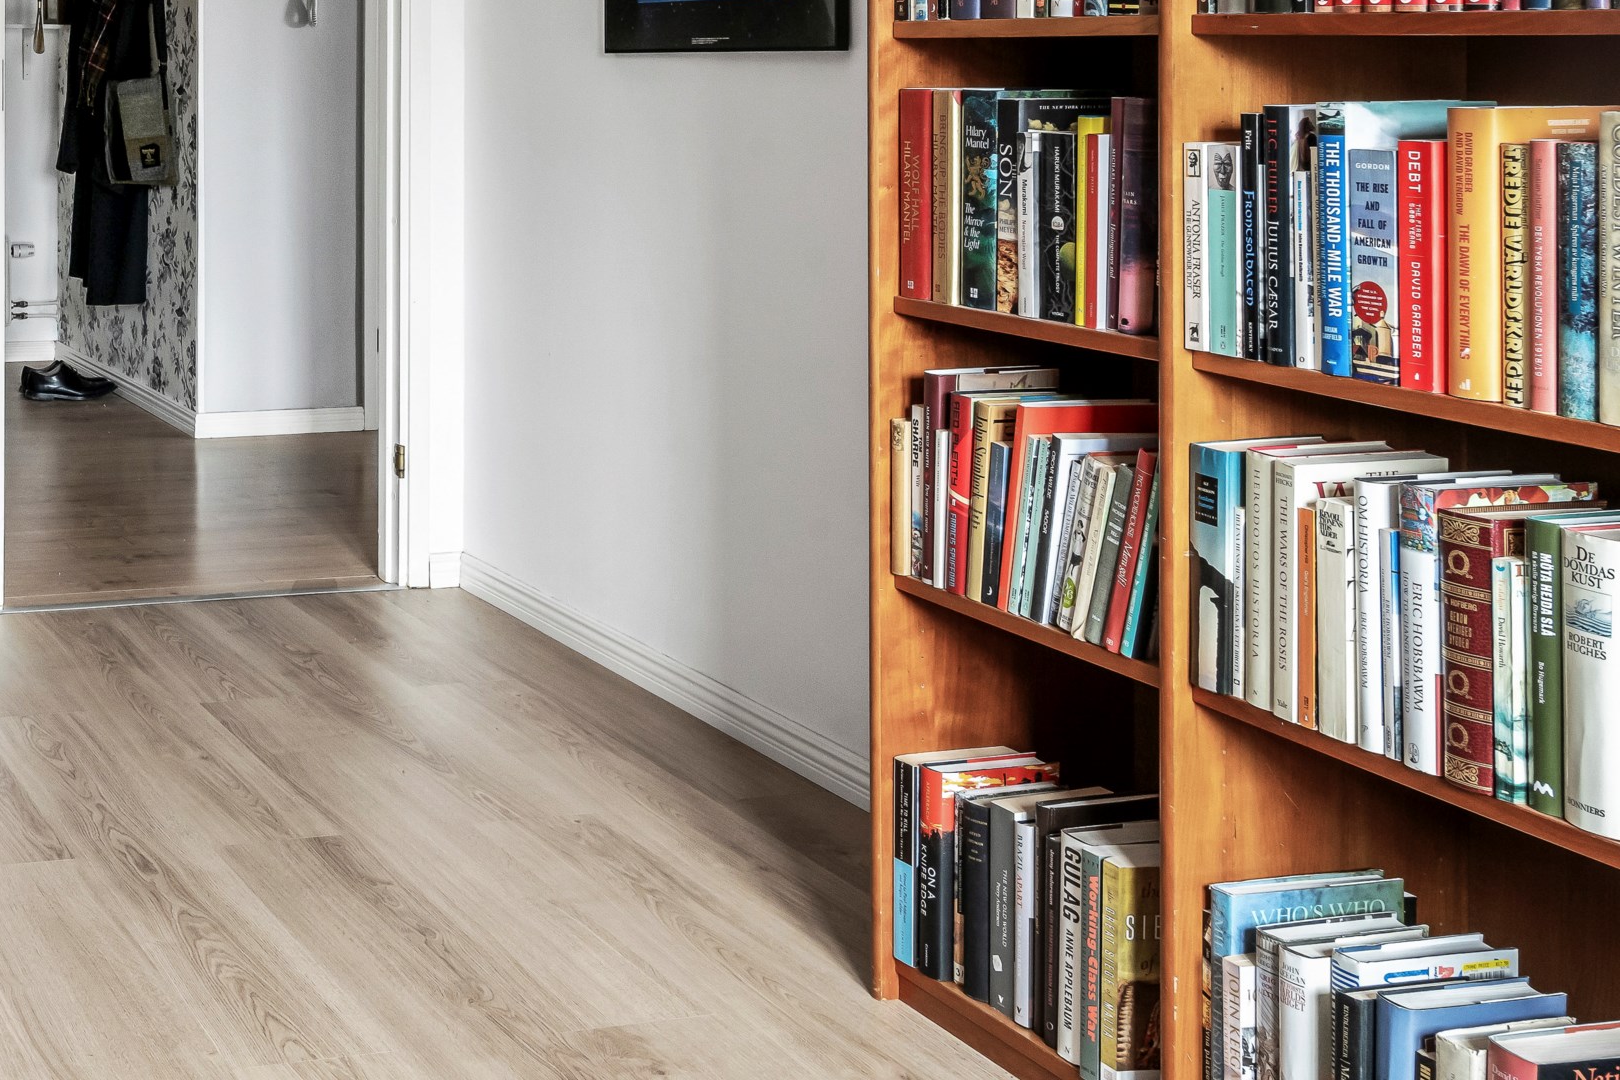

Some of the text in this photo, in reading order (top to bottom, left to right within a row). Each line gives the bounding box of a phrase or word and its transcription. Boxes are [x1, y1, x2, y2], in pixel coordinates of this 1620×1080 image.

[966, 125, 987, 140] Hilary
[966, 136, 990, 149] Mantel
[1000, 144, 1012, 198] SON
[1355, 162, 1390, 171] GORDON
[1408, 150, 1421, 193] DEBT
[1464, 159, 1473, 193] GRAEBER
[903, 141, 911, 243] HILARY MANTEL
[1356, 182, 1389, 194] THE RISE
[1365, 201, 1380, 212] AND
[1455, 173, 1464, 215] WENGROW
[1267, 220, 1279, 270] JULIUS
[1326, 141, 1342, 317] THE WAR
[1354, 237, 1391, 249] AMERICAN
[1358, 219, 1387, 230] FALL OF
[1357, 254, 1388, 267] GROWTH
[1411, 262, 1422, 359] DAVID GRAEBER
[1534, 275, 1543, 339] REVOLUTIONEN
[912, 419, 920, 468] SHARPE
[951, 433, 960, 487] PLENTY
[1252, 469, 1260, 658] HERODOTOS HISTORIA
[1358, 525, 1369, 594] HISTORIA
[1576, 545, 1596, 564] DE
[1279, 496, 1288, 671] THE WARS THE ROSES
[1571, 571, 1604, 589] KUST
[1566, 640, 1608, 661] HUGHES
[1568, 631, 1605, 651] ROBERT
[1412, 617, 1423, 712] HOBSBAWM
[927, 867, 936, 887] ON
[1063, 846, 1081, 1030] GULAG ANNE APPLEBAUM
[1088, 875, 1099, 1042] Working-Class War
